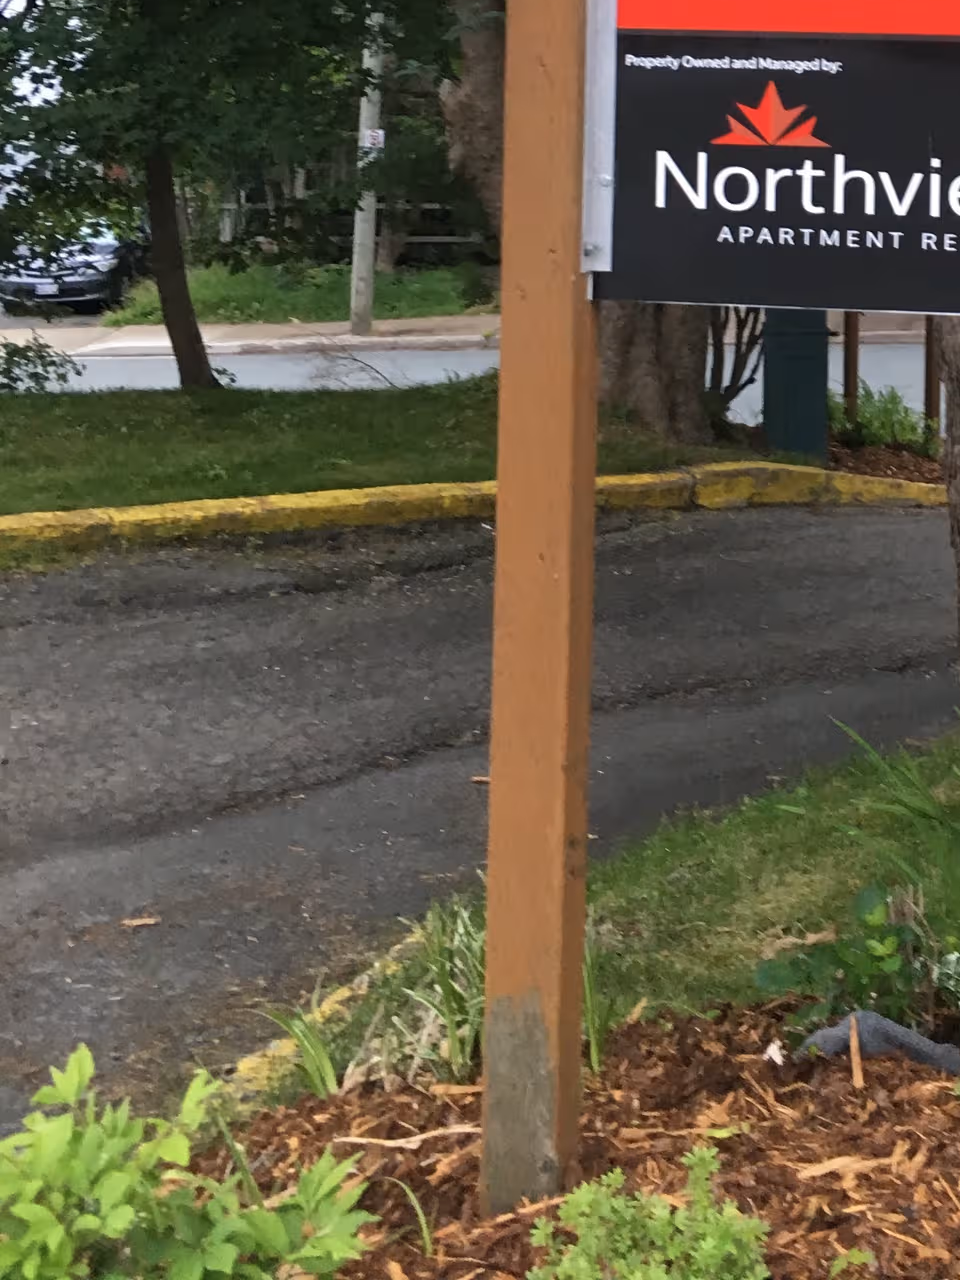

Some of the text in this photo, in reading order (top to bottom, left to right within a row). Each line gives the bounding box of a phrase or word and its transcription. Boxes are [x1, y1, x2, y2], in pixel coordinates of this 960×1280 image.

[624, 53, 681, 71] Property
[681, 55, 731, 70] Owned
[731, 56, 758, 71] and
[758, 57, 821, 74] Managed
[716, 225, 905, 249] APARTMENT
